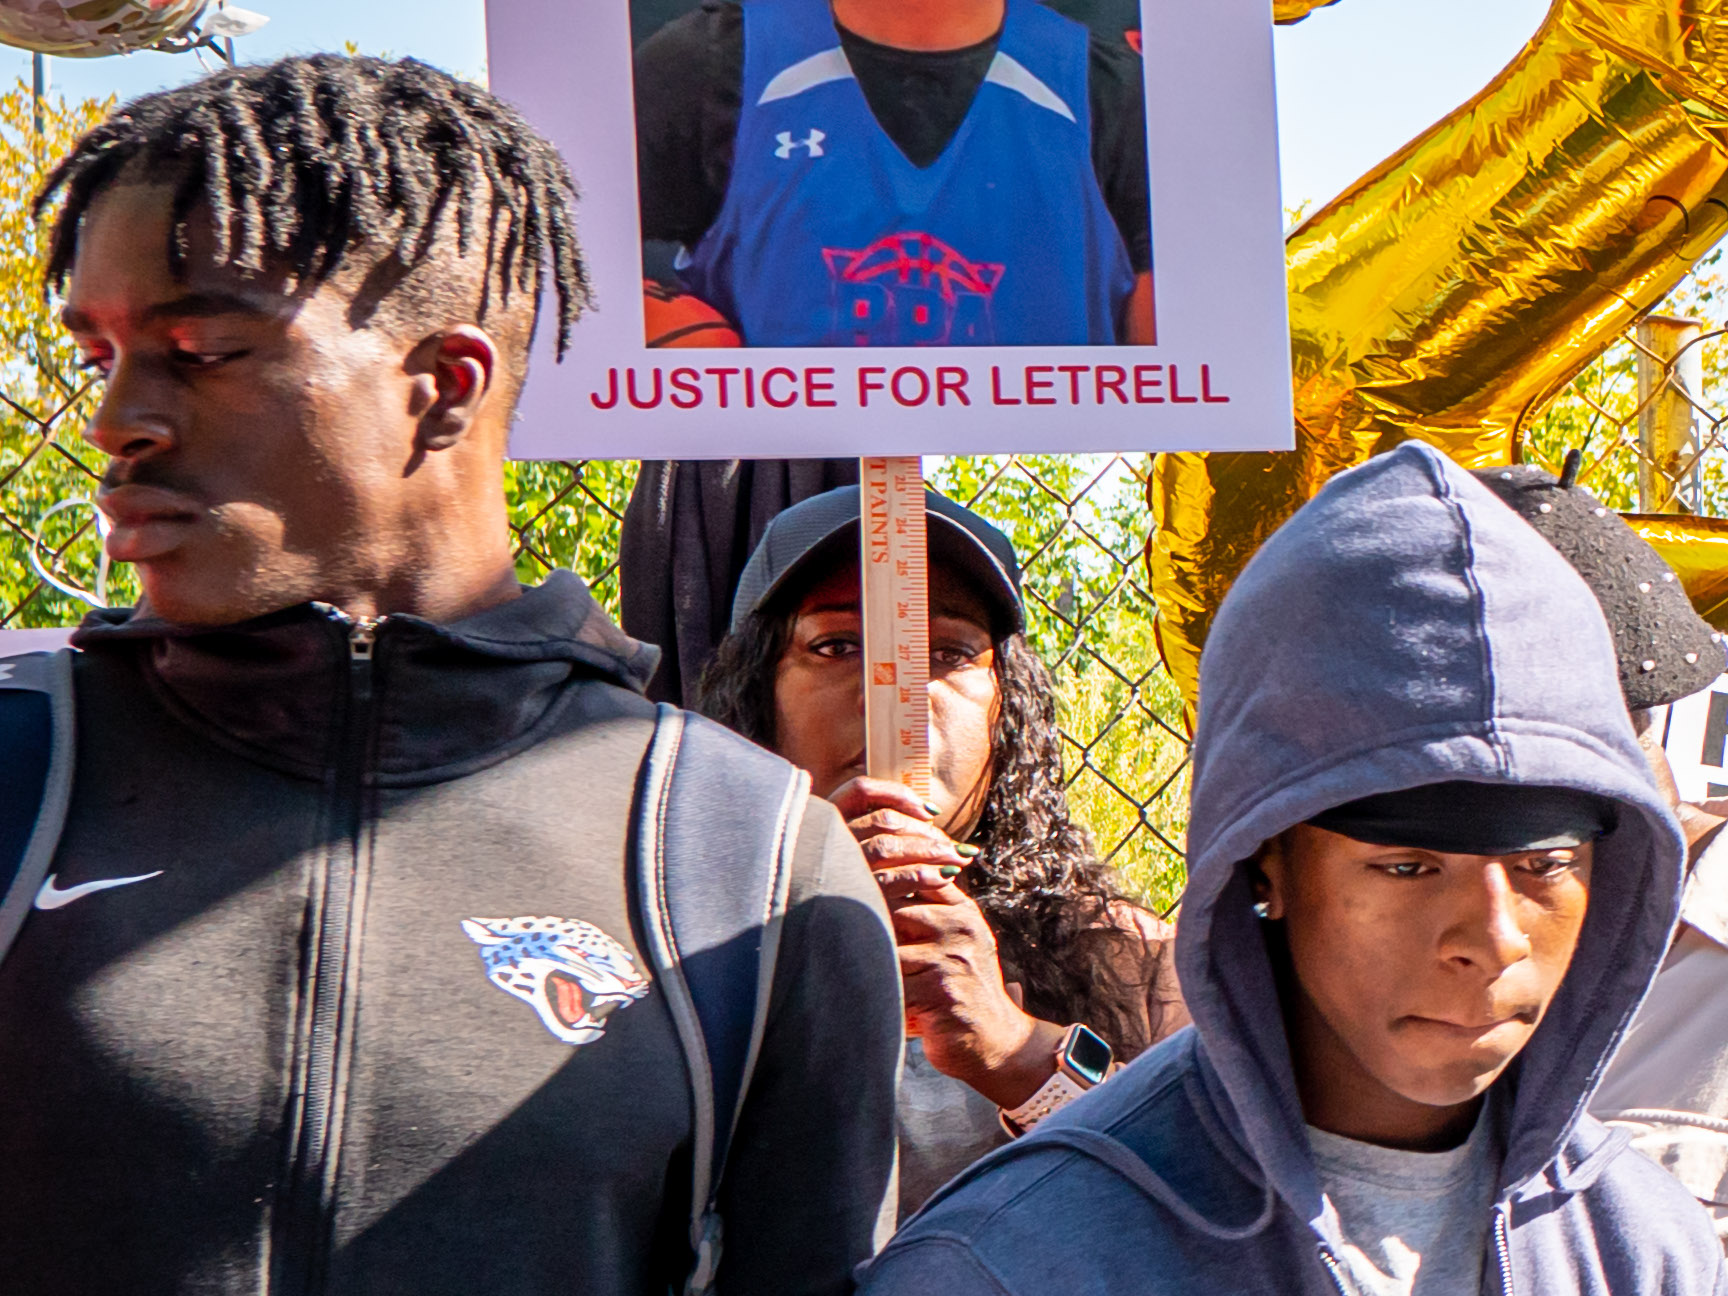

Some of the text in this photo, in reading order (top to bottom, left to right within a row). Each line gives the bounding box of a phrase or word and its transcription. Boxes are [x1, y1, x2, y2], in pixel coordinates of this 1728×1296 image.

[591, 364, 1231, 411] JUSTICE FOR LETRELL
[870, 482, 890, 564] PAINTS
